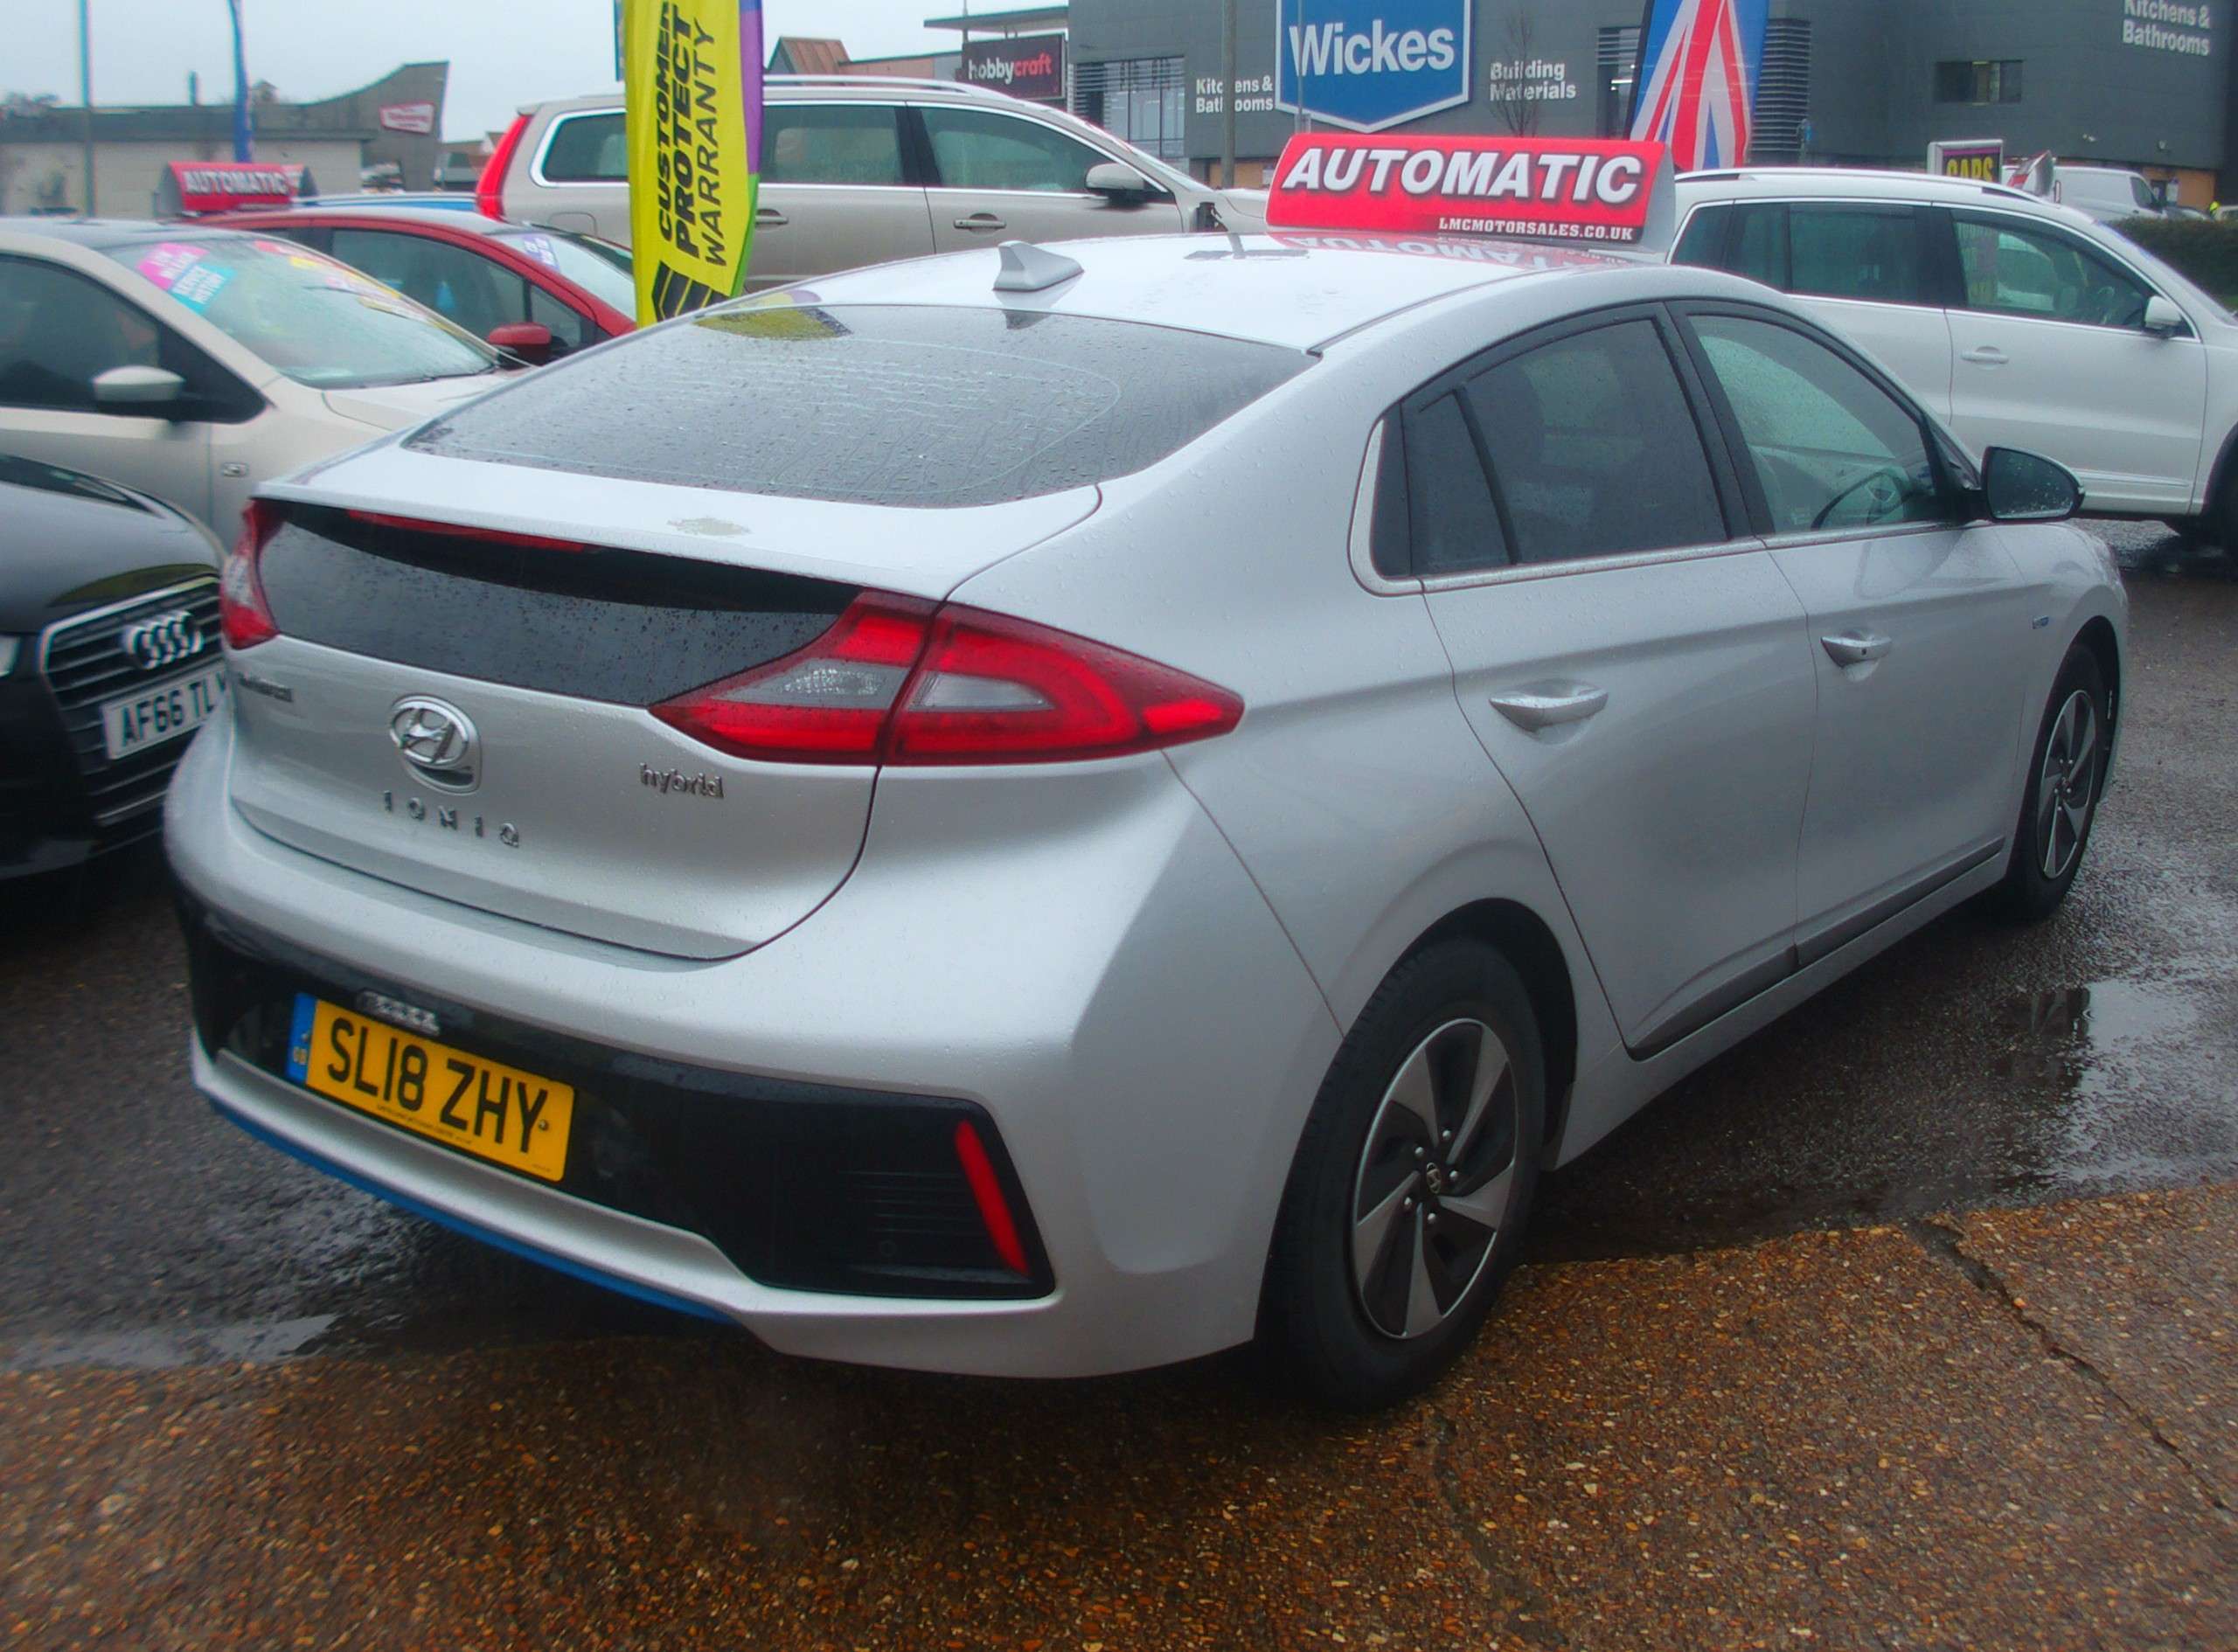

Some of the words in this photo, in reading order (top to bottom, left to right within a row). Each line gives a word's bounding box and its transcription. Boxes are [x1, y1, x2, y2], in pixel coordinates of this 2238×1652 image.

[1289, 18, 1455, 77] Wickes
[2123, 18, 2211, 57] Bathrooms
[968, 52, 1053, 85] hobbycraft
[1196, 77, 1260, 94] Kitcens
[1261, 74, 1274, 92] &
[1490, 59, 1566, 81] Building
[672, 3, 700, 259] PROTECT
[693, 16, 727, 267] WARRANTY
[181, 170, 289, 196] AUTOMATIC
[1281, 147, 1643, 205] AUTOMATIC
[1438, 217, 1634, 240] LMCMOTORSALES.CO.UK
[122, 690, 184, 747] AF66
[639, 761, 725, 799] hybrid
[327, 1017, 428, 1112] SL18
[440, 1058, 549, 1154] ZHY
